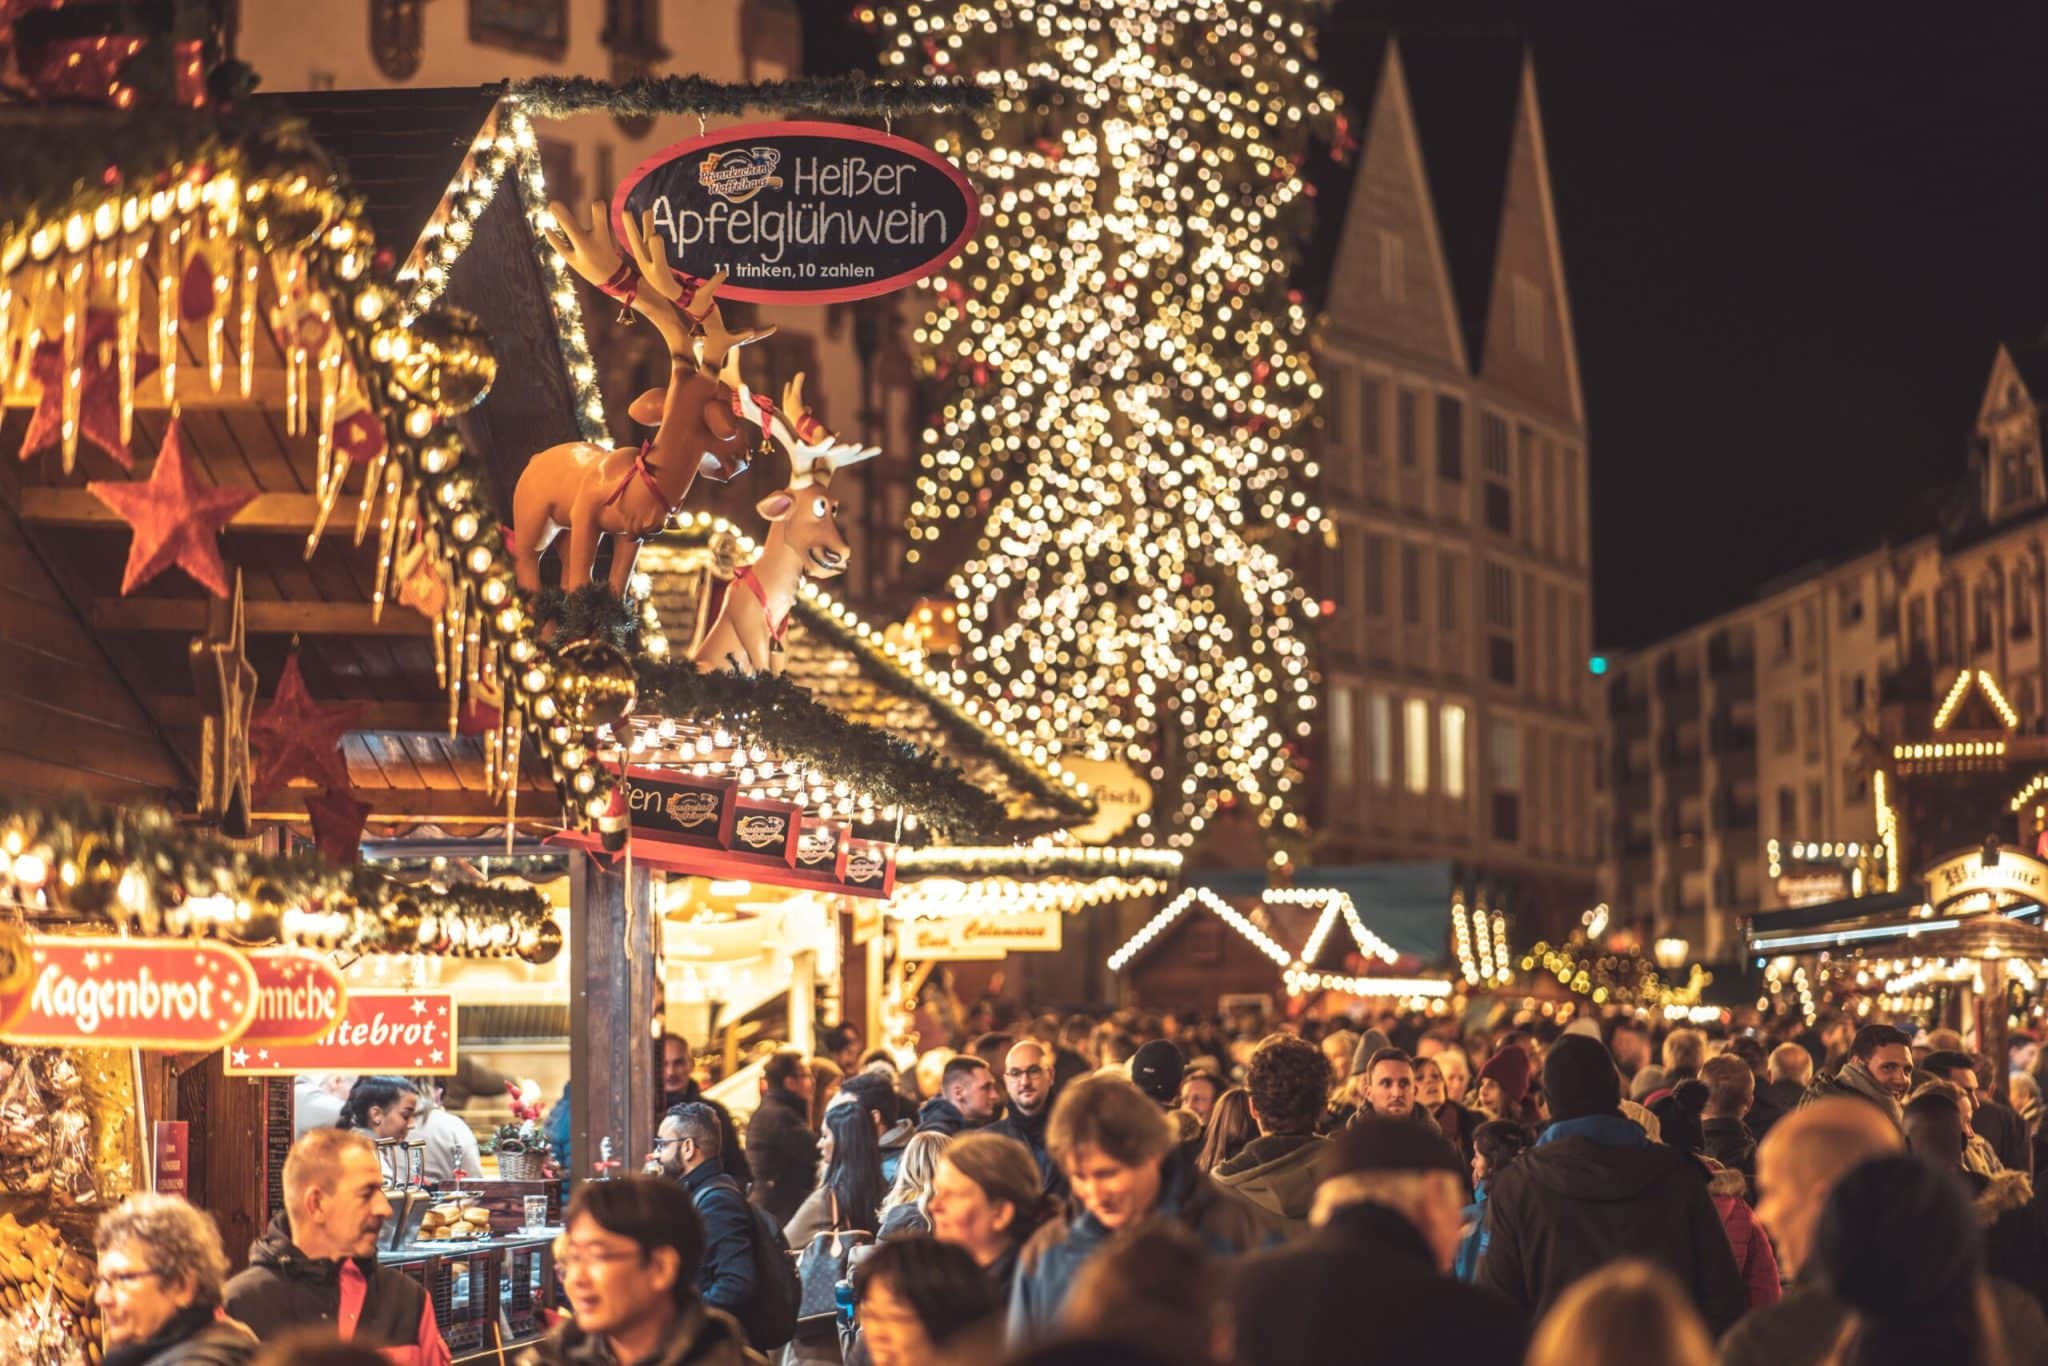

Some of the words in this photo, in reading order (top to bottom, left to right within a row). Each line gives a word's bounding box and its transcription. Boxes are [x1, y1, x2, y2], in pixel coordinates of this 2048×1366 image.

[795, 156, 917, 198] Heißer
[653, 195, 947, 263] Apfelglühwein
[820, 262, 875, 278] zahlen
